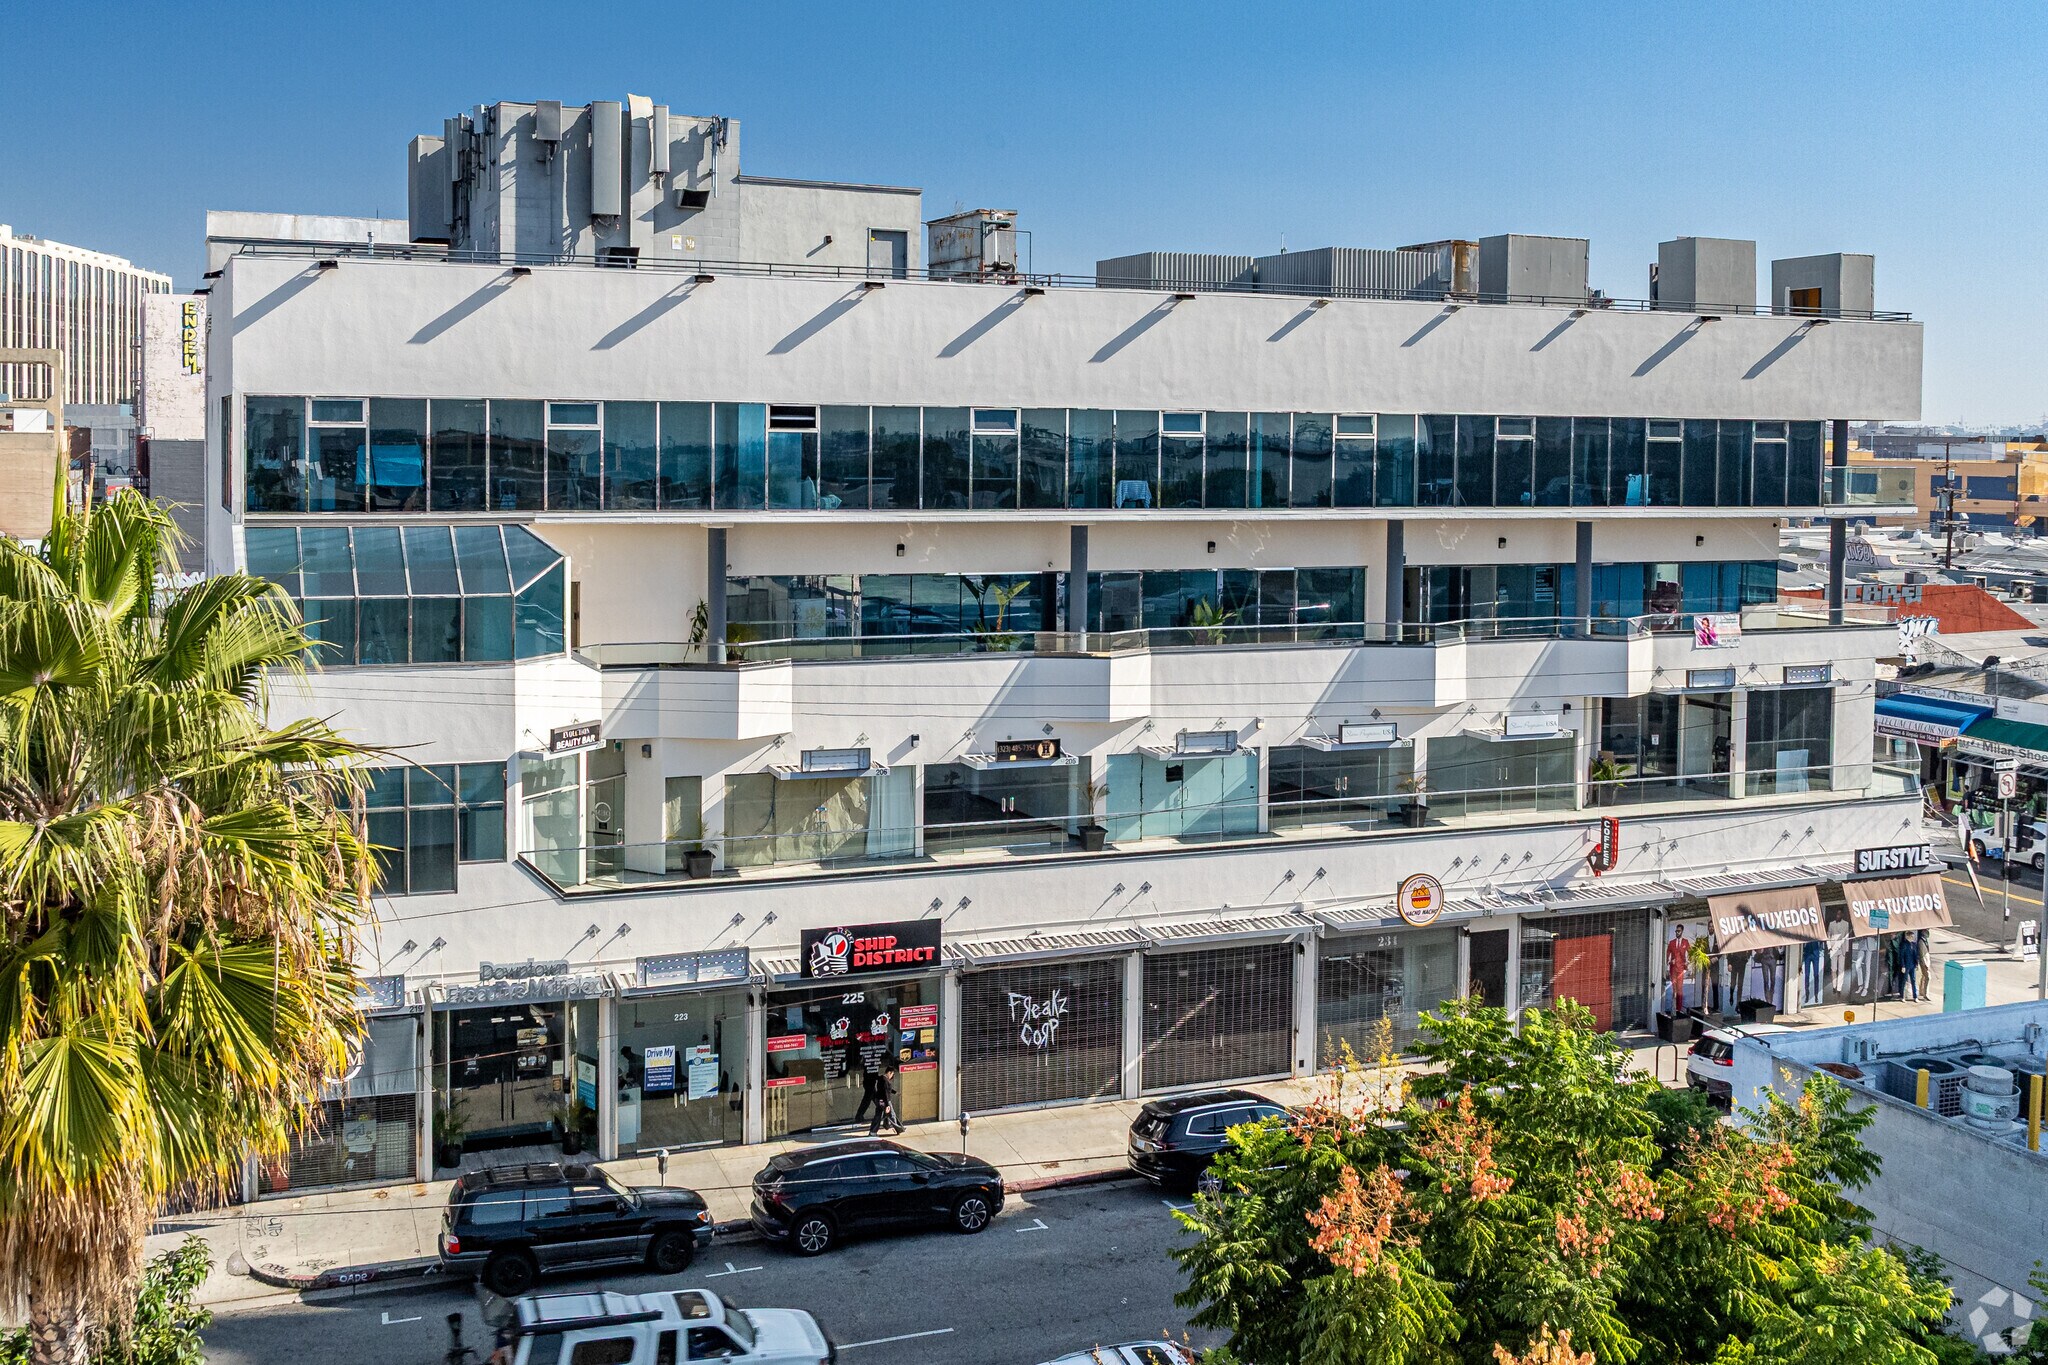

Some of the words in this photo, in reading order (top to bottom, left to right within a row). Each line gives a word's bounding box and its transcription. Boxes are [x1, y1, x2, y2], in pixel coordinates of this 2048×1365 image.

[1908, 723, 1935, 734] TAILOR
[1937, 727, 1958, 737] SHOP
[556, 737, 581, 750] BEAUTY
[581, 734, 595, 745] BAR
[1982, 740, 2014, 757] Milan
[875, 769, 888, 777] 206
[1603, 820, 1611, 866] COFFEE
[1884, 893, 1942, 915] TUXEDOS
[1719, 915, 1747, 936] SUIT
[1748, 915, 1757, 932] &
[1757, 906, 1819, 931] TUXEDOS
[853, 936, 898, 952] SHIP
[853, 946, 935, 967] DISTRICT
[480, 958, 568, 981] Downtown
[842, 992, 864, 1005] 225
[409, 1005, 423, 1013] 219
[674, 1013, 688, 1021] 223
[646, 1049, 663, 1058] Drive
[663, 1047, 674, 1057] My
[912, 1048, 936, 1058] FedEx
